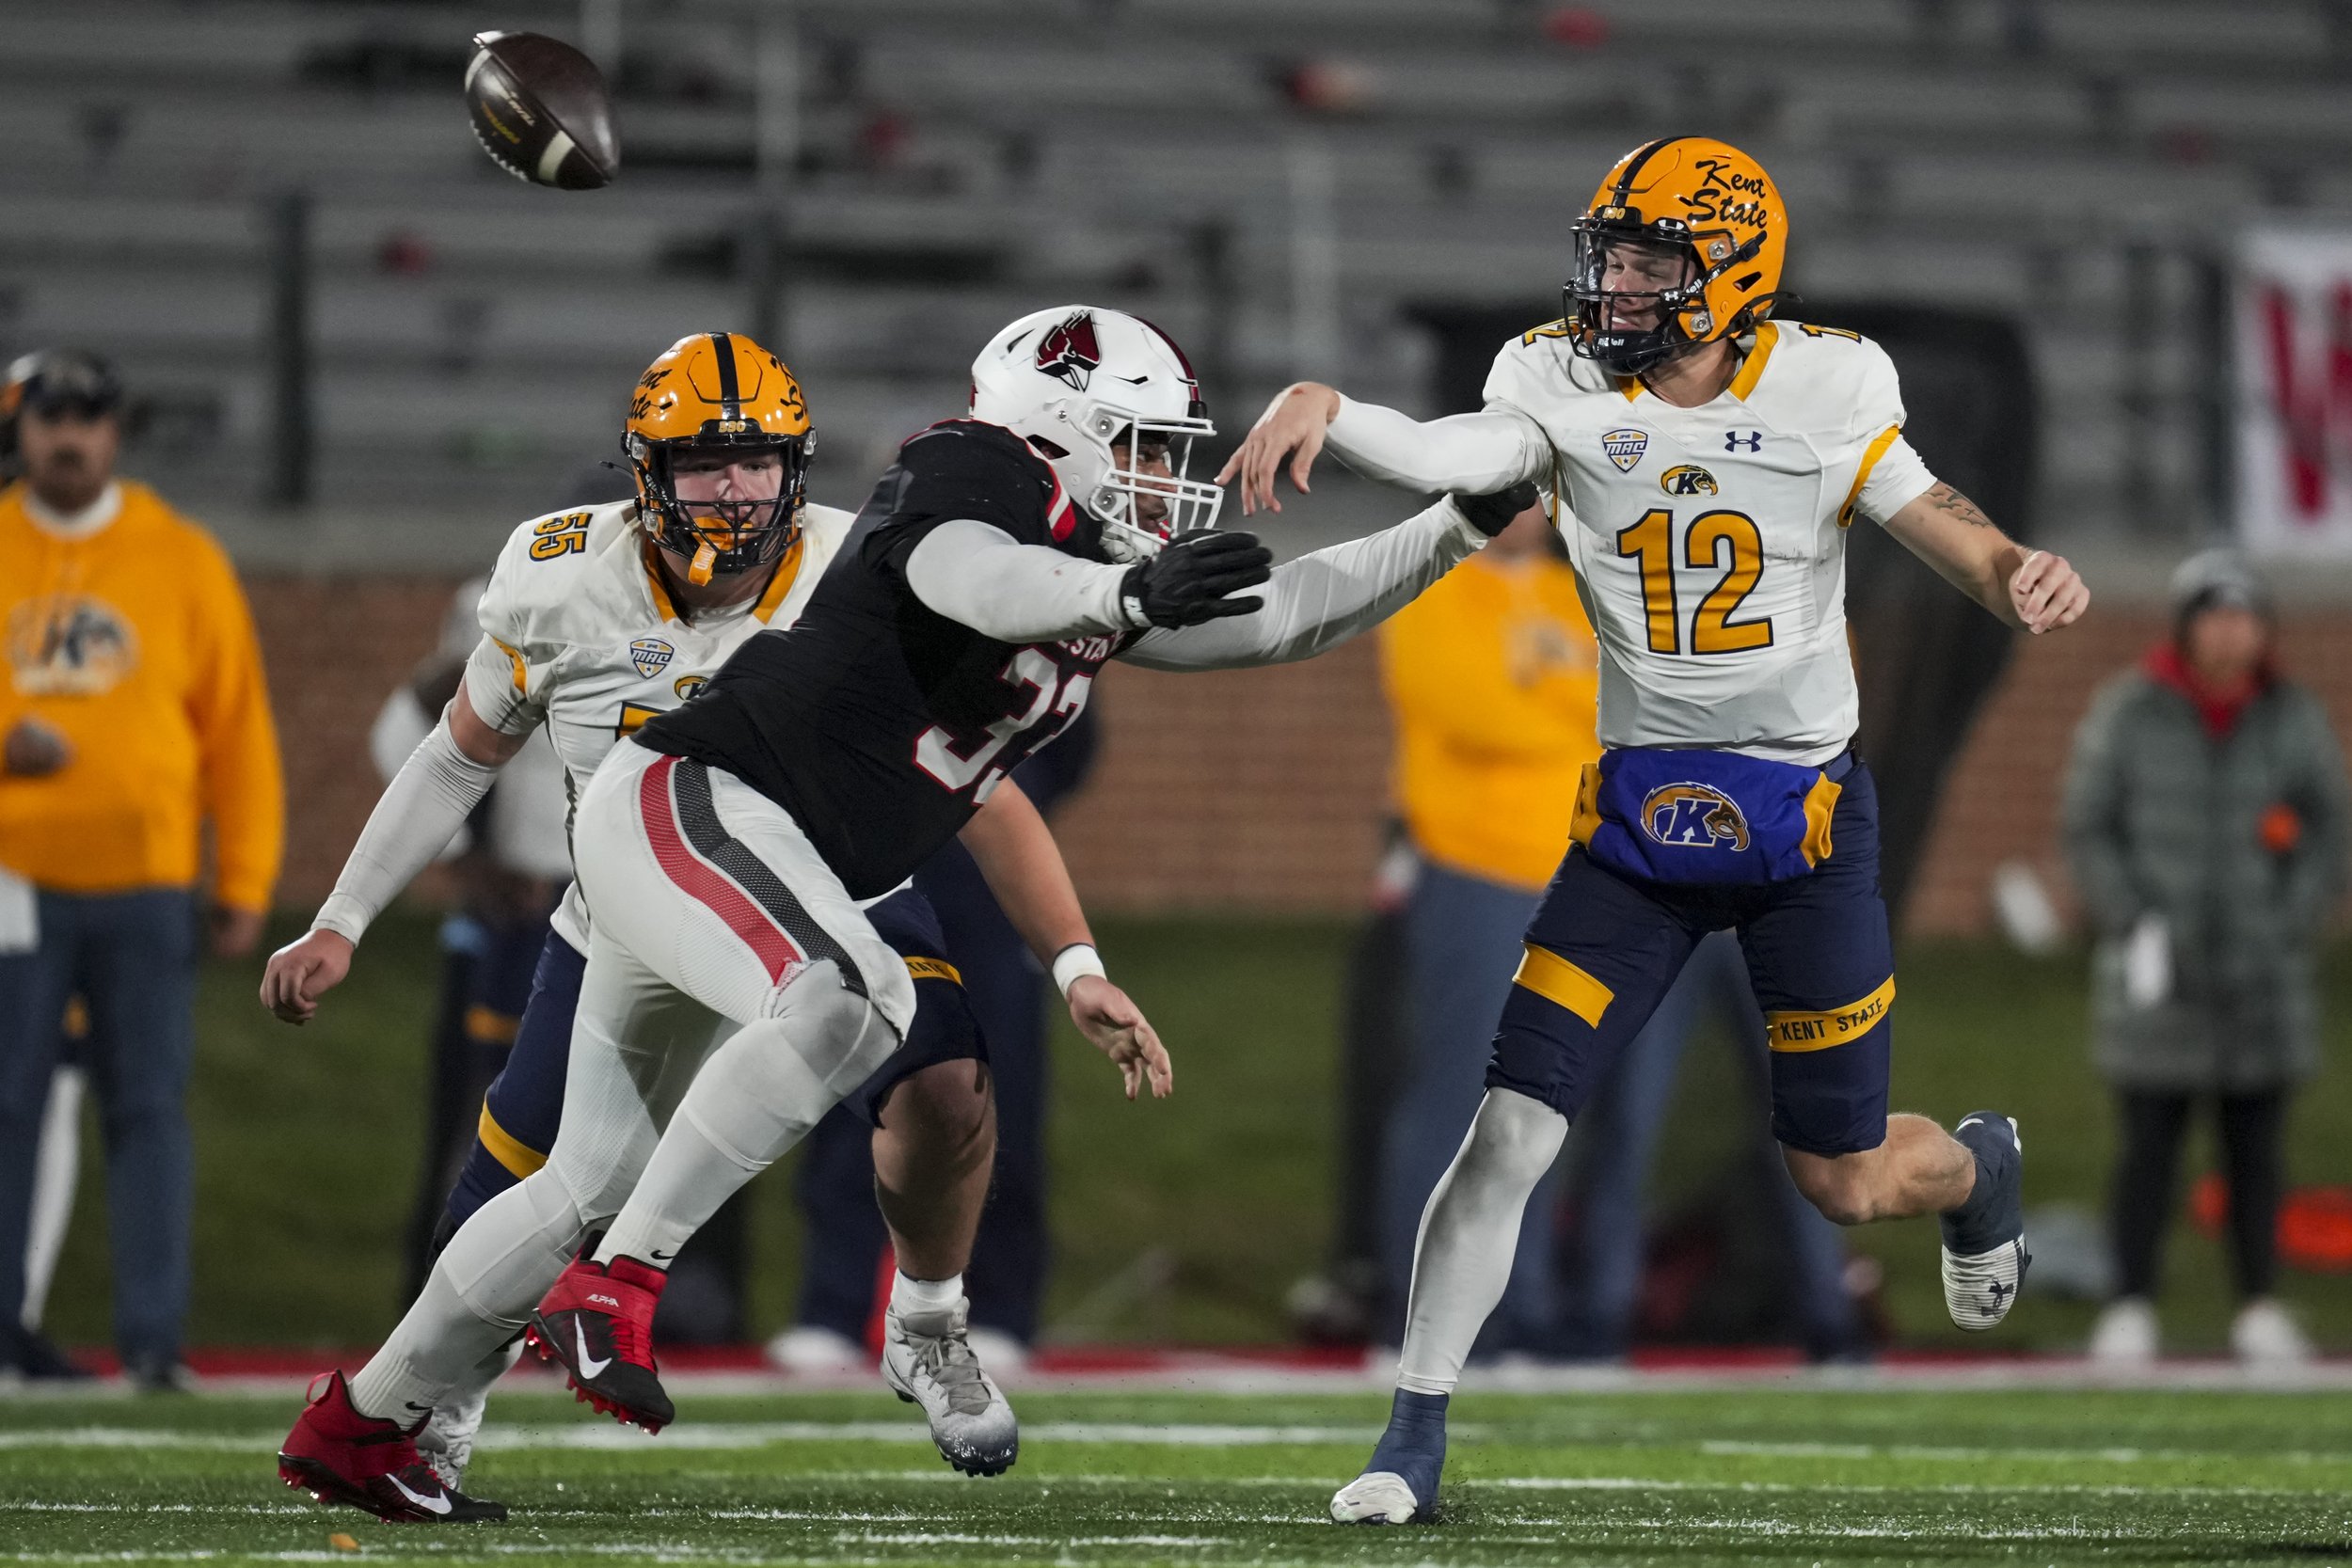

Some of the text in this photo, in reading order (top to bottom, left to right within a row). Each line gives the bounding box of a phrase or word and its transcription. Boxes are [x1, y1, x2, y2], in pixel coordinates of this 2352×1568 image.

[1695, 160, 1766, 198] Kent
[1687, 189, 1768, 229] State
[1607, 441, 1646, 455] MAC
[1675, 472, 1703, 495] K
[529, 513, 593, 562] 55
[1616, 509, 1773, 656] 12
[632, 649, 671, 664] MAC
[1662, 797, 1722, 847] K
[1780, 997, 1883, 1041] KENT STATE
[587, 1293, 619, 1307] ALPHA
